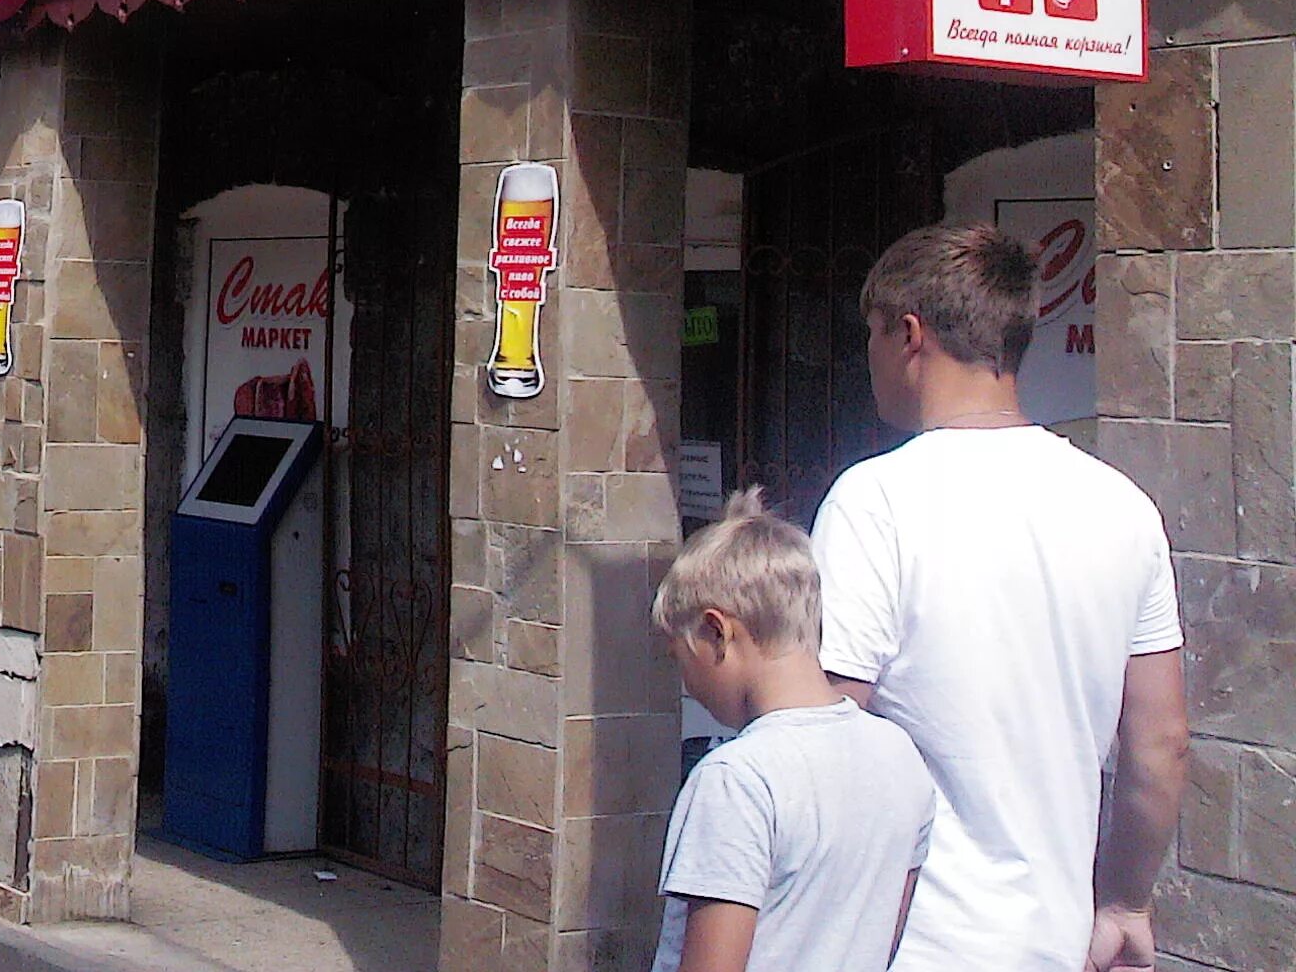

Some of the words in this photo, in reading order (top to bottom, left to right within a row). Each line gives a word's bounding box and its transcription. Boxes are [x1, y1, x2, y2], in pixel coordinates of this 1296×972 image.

[947, 18, 998, 48] Всегда
[1004, 31, 1059, 49] полная
[1065, 34, 1132, 58] корзина!
[505, 218, 541, 230] Всегда
[240, 327, 312, 350] МАРКЕТ
